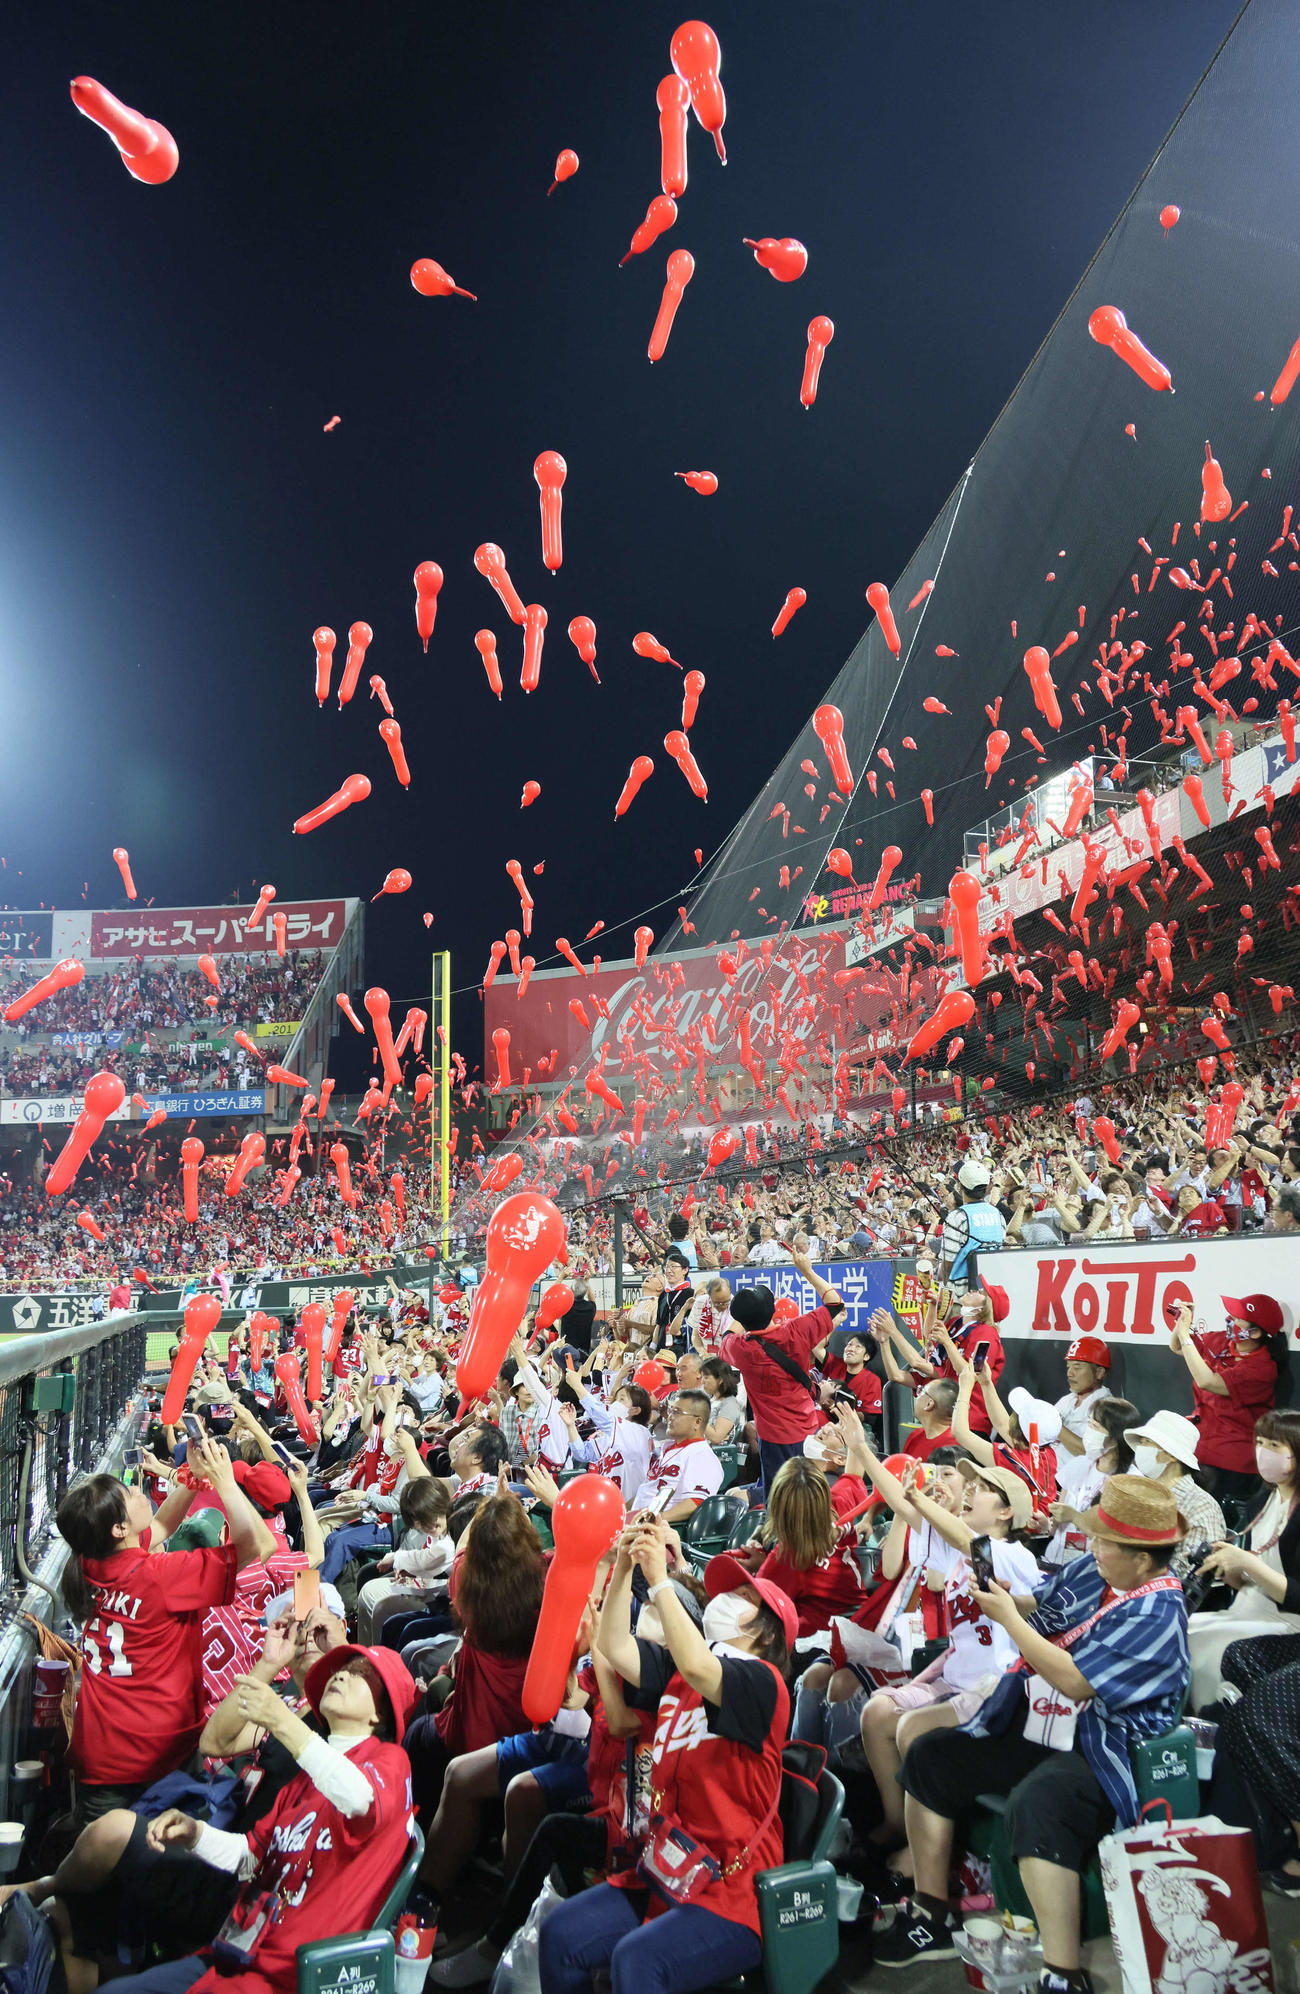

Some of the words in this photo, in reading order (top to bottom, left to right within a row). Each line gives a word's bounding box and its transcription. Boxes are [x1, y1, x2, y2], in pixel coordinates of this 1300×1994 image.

[274, 1025, 291, 1034] 201
[193, 1095, 263, 1111] ひろぎん証券
[47, 1297, 139, 1328] 五洋
